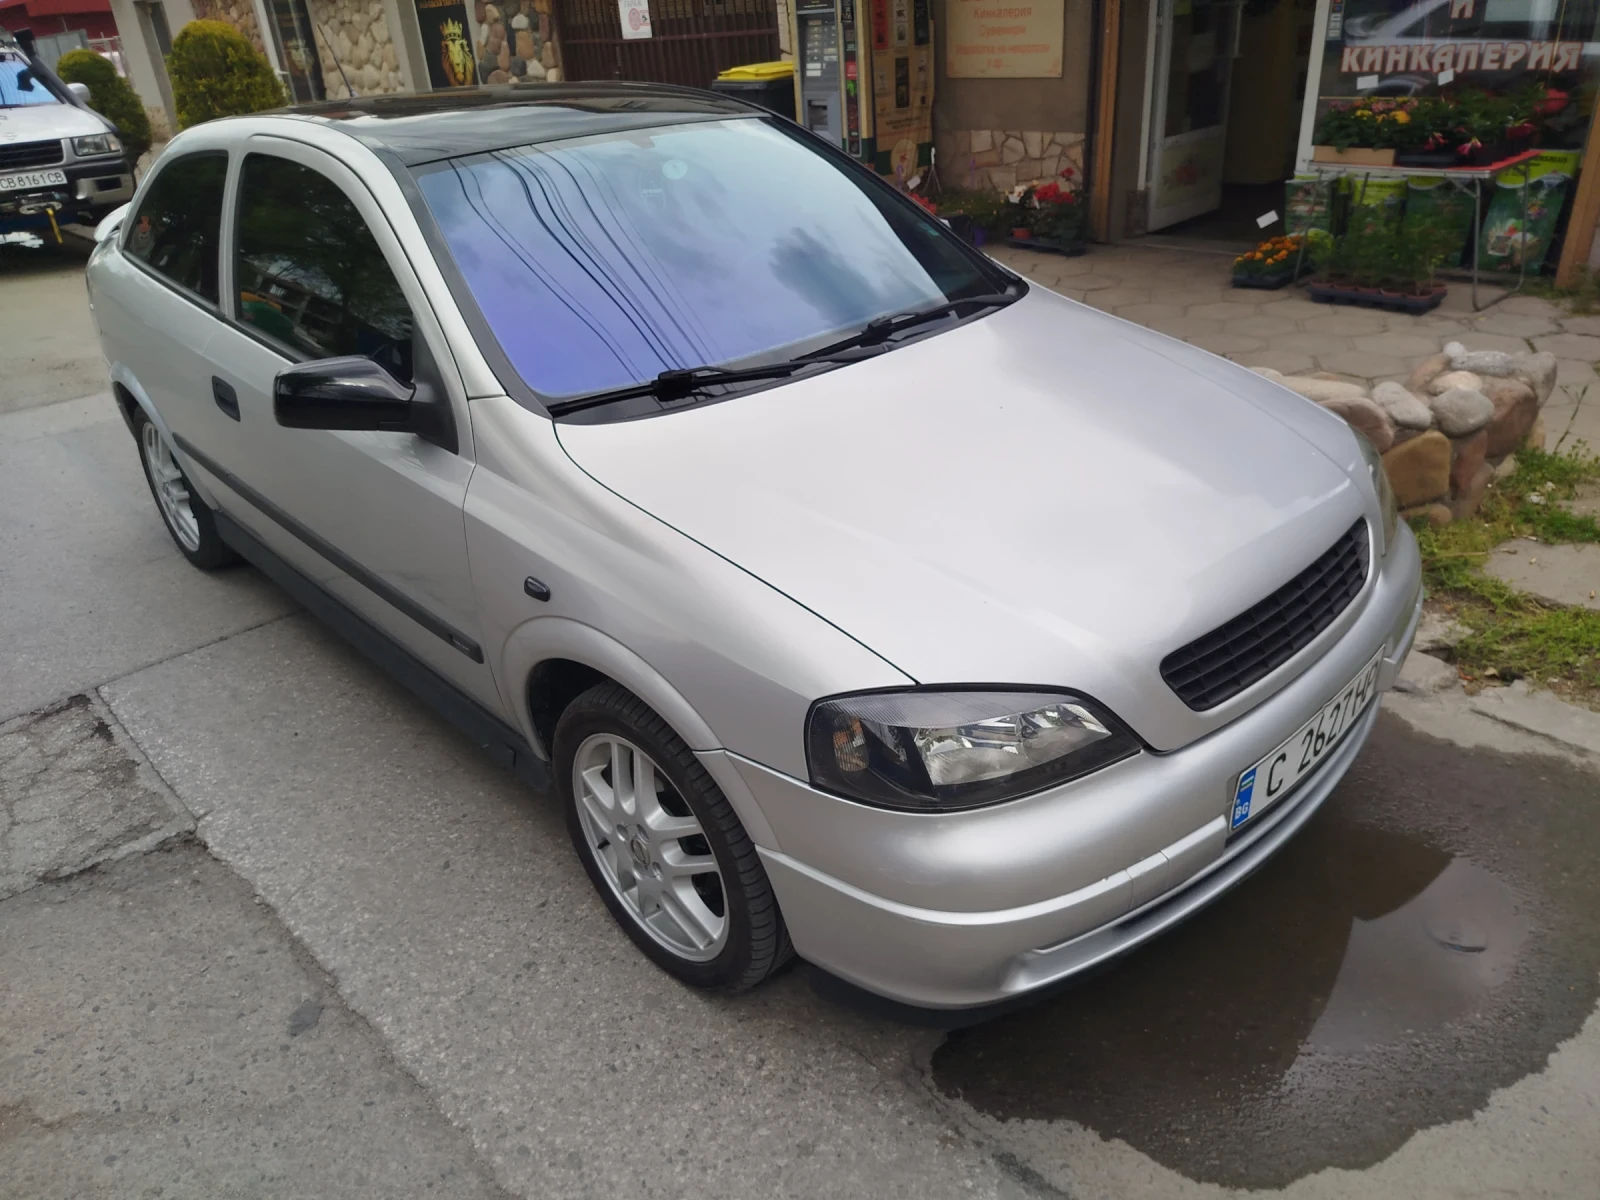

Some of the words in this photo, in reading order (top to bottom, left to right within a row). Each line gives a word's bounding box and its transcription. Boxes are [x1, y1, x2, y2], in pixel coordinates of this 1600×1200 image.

[973, 7, 1032, 19] Кинкалерия
[1341, 43, 1583, 74] КИНКАЛЕРИЯ
[17, 174, 46, 187] 8161
[47, 171, 64, 184] CB
[1266, 752, 1286, 798] C
[1234, 804, 1249, 819] BG
